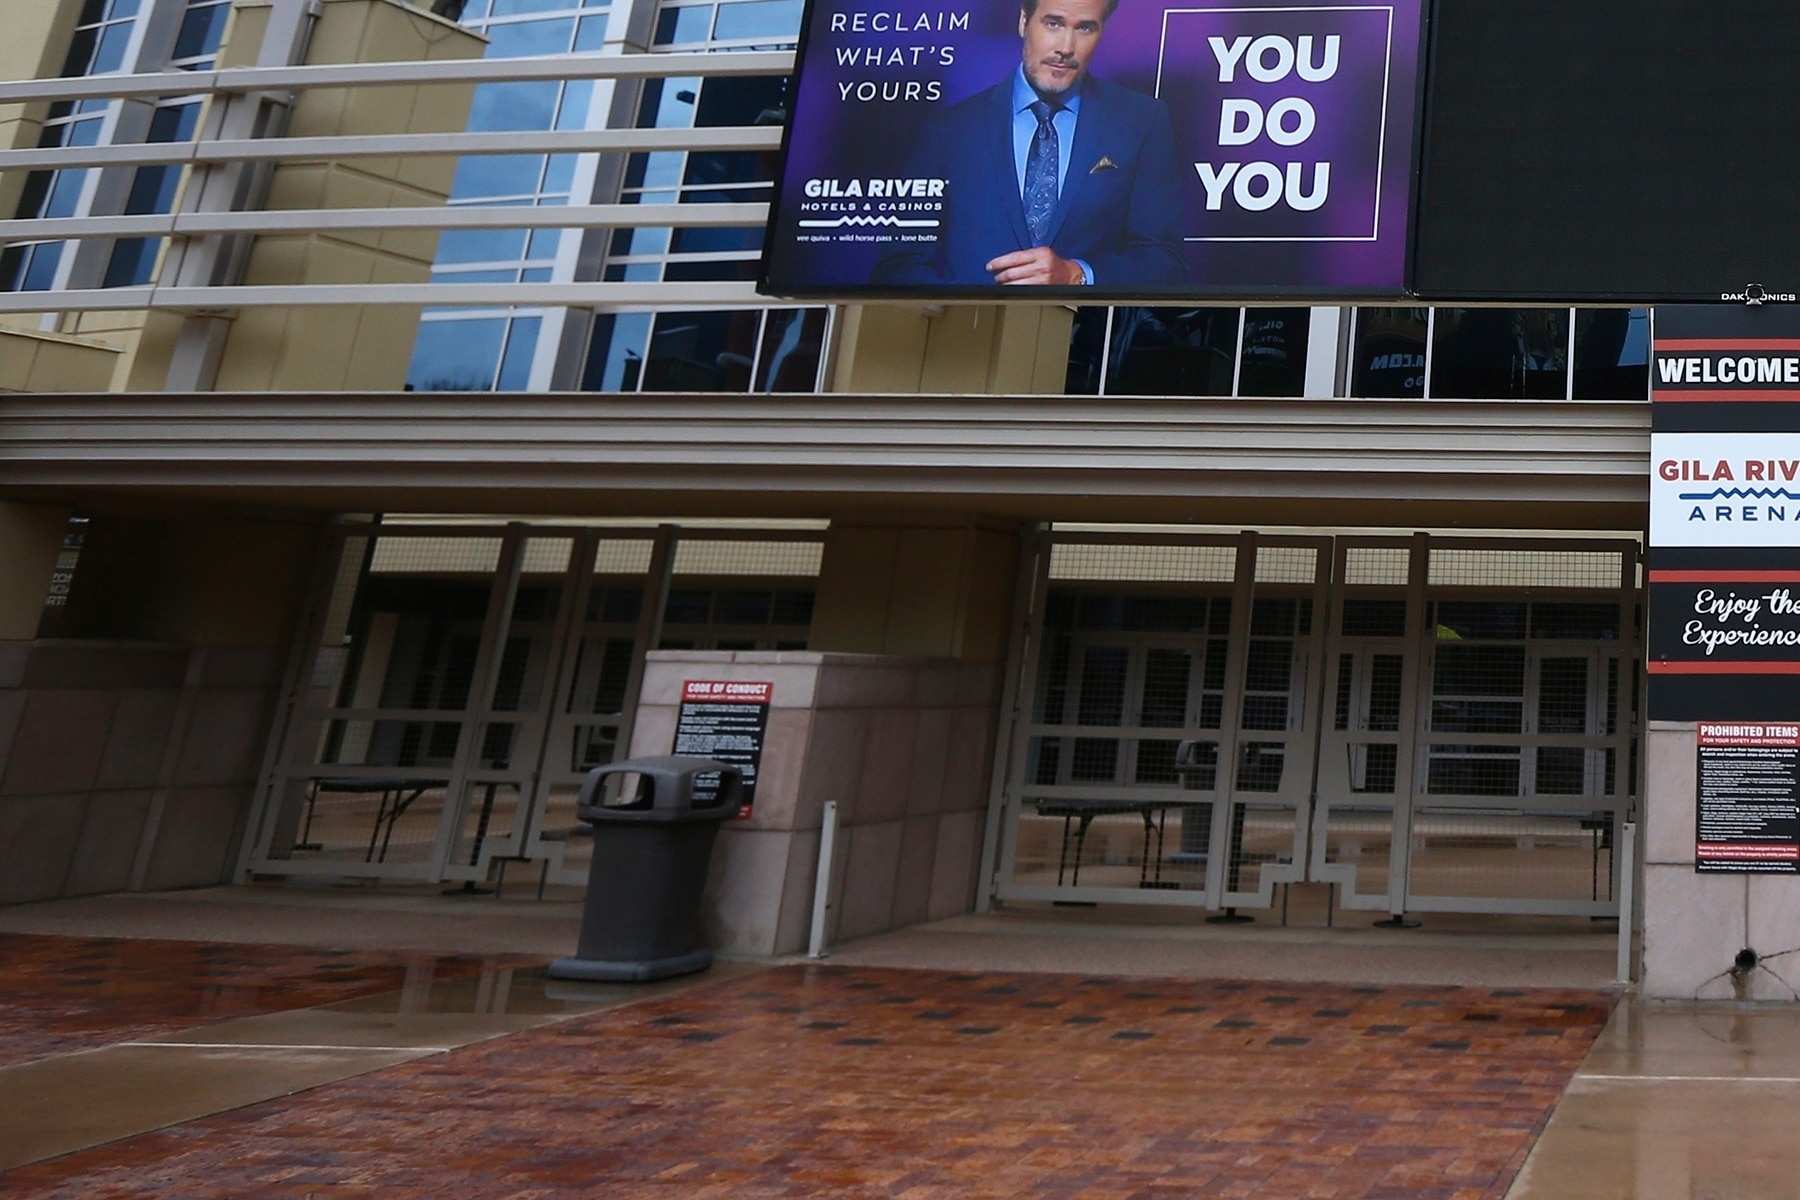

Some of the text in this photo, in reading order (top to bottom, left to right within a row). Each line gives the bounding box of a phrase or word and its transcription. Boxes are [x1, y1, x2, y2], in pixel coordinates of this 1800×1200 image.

[830, 11, 970, 34] RECLAIM
[836, 45, 956, 67] WHAT'S
[1207, 34, 1341, 83] YOU
[838, 81, 943, 102] YOURS
[1218, 98, 1316, 146] DO
[804, 179, 945, 197] GILA RIVER
[1194, 161, 1331, 212] YOU
[801, 202, 943, 211] HOTELS & CASINOS
[839, 234, 854, 242] wild
[855, 234, 875, 242] horse
[875, 235, 892, 243] pass
[901, 234, 917, 242] lone
[918, 234, 938, 242] butte
[1721, 293, 1796, 302] DAKONICS
[1657, 357, 1800, 384] WELCOME
[1658, 459, 1734, 482] GILA
[1694, 589, 1761, 624] Enjoy
[688, 683, 768, 694] CODE OF CONDUCT
[1701, 726, 1799, 737] PROHIBITED ITEMS
